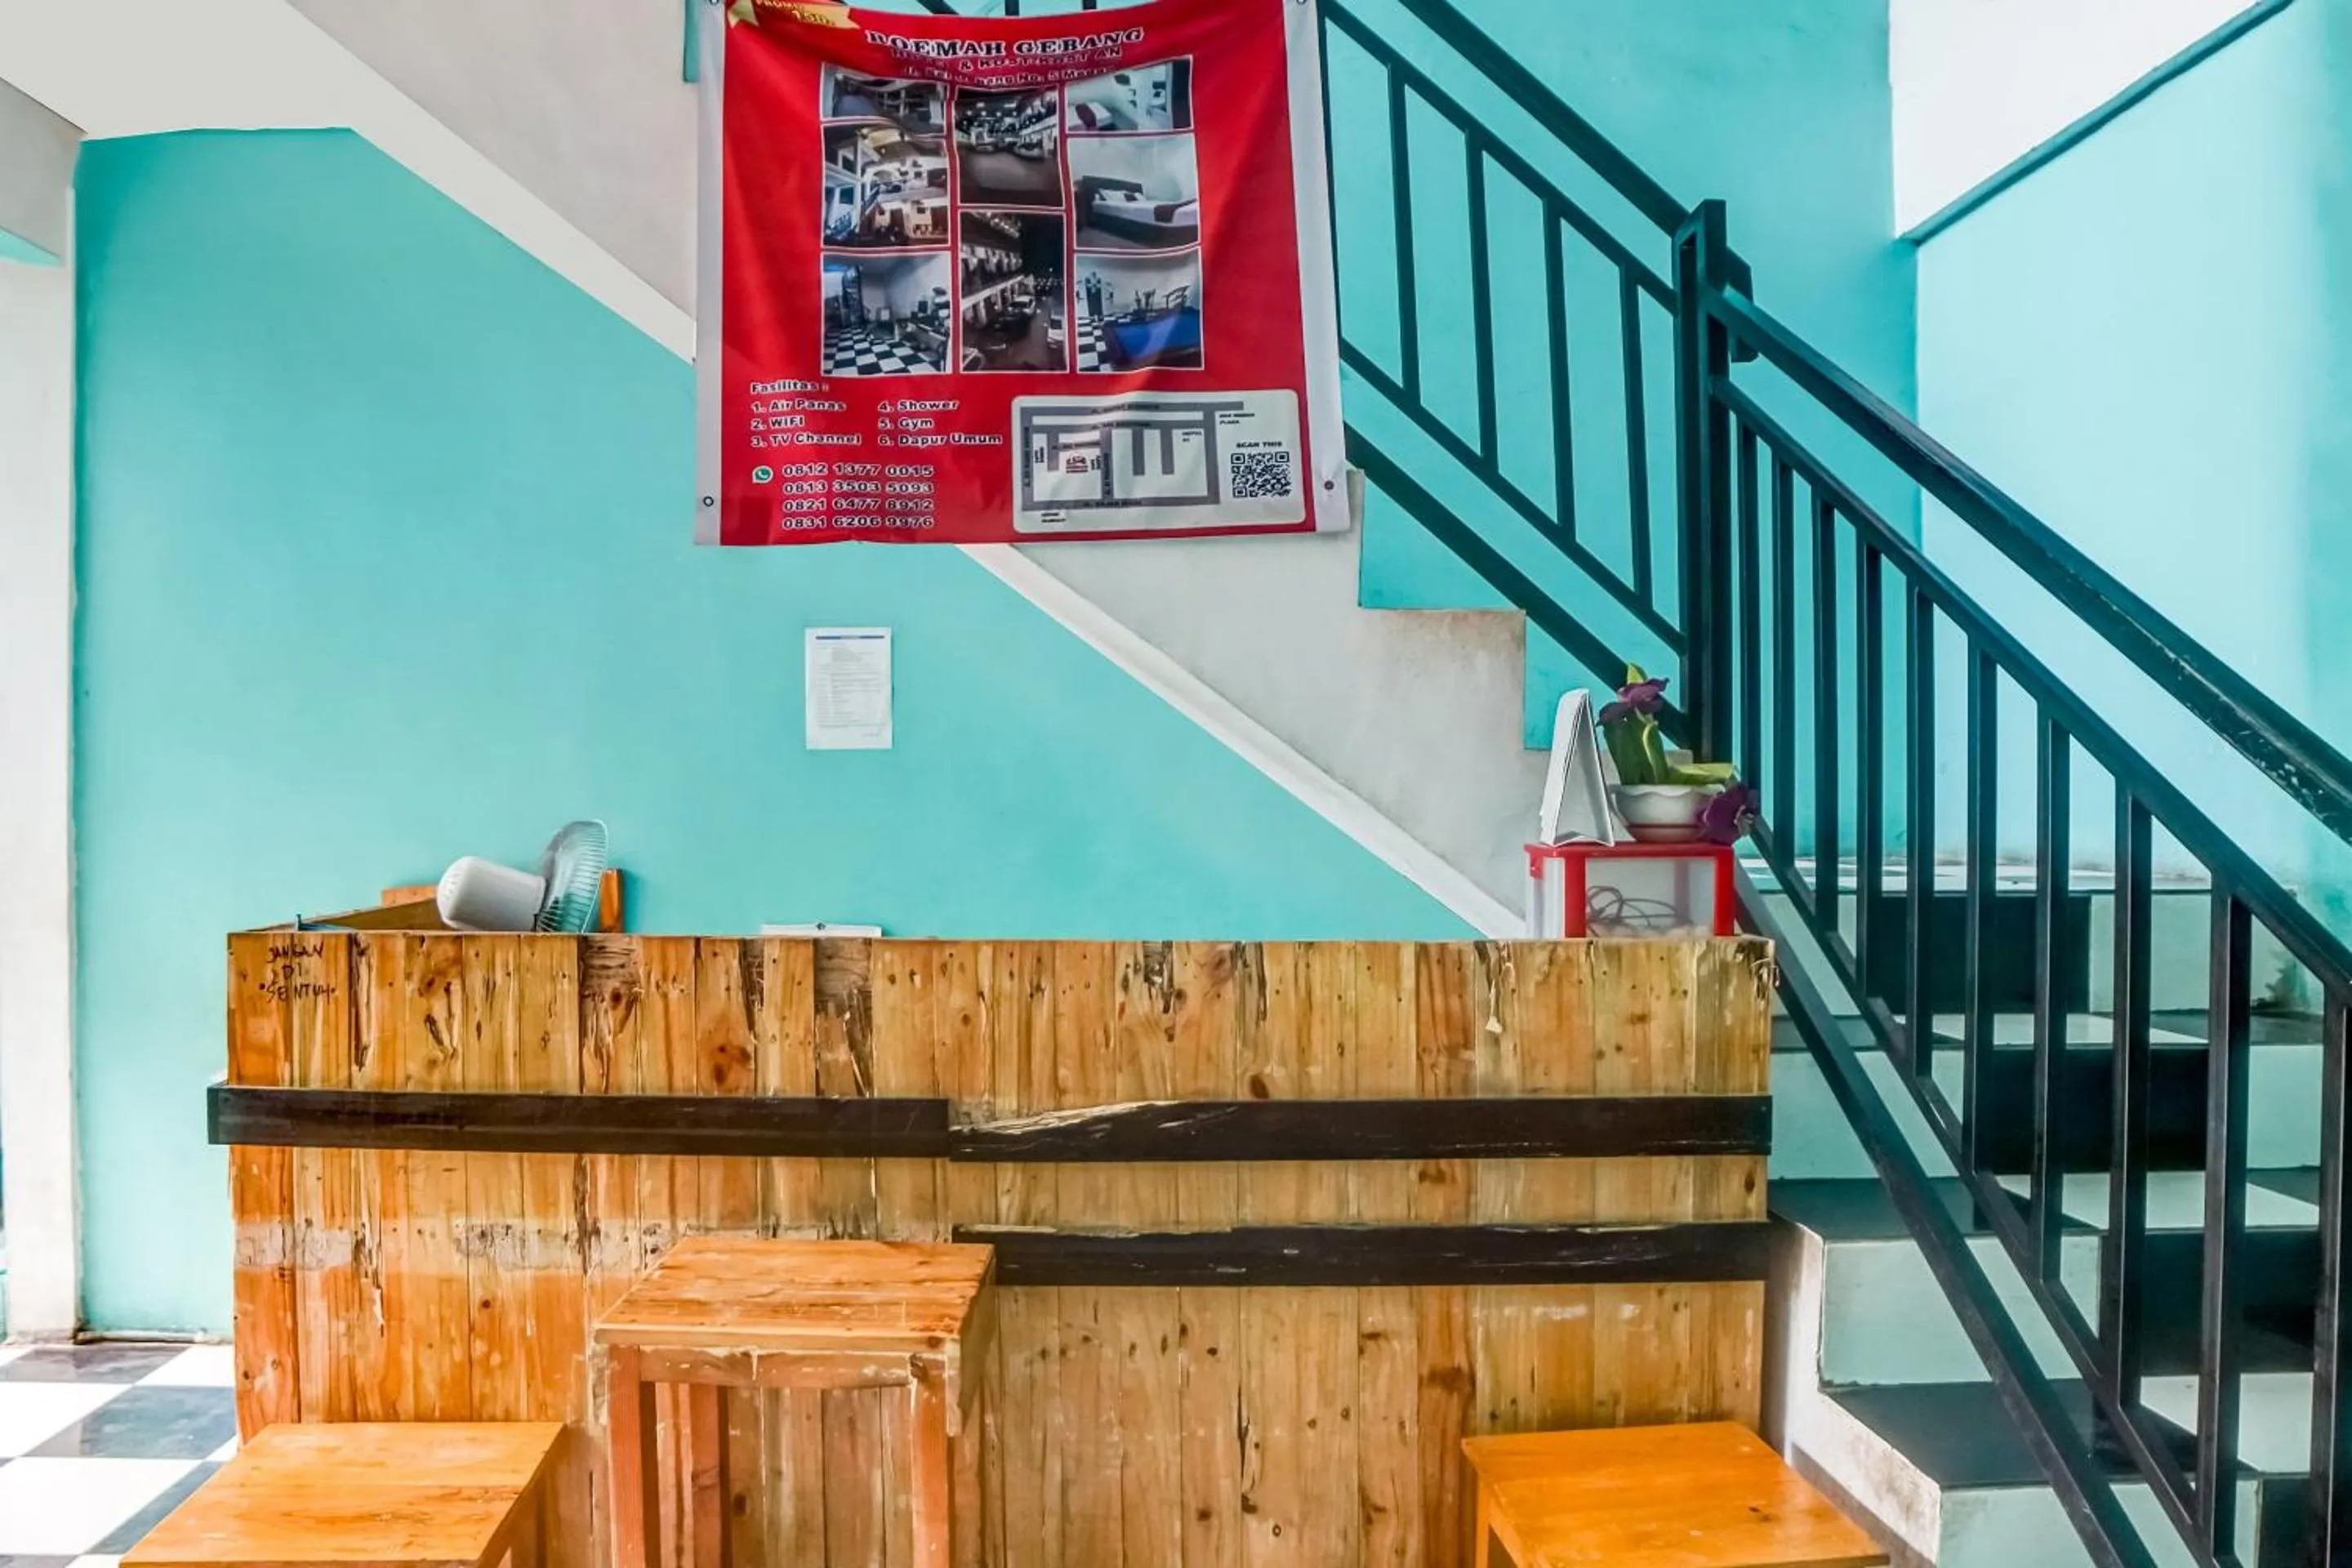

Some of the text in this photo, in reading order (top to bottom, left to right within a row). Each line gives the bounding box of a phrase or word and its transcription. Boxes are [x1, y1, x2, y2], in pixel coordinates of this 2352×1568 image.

[751, 379, 819, 394] Fasilitas
[752, 399, 847, 412] 1. Air Panas
[878, 399, 960, 412] 4. Shower
[751, 418, 766, 430] 2.
[878, 417, 934, 431] 5. Gym
[751, 430, 862, 448] 3. TV Channel
[878, 432, 1003, 448] 6. Dapur Umum
[782, 463, 934, 477] 0812 1377 0015
[782, 480, 827, 495] 0813
[832, 480, 881, 492] 3503
[782, 498, 826, 512] 0821
[832, 498, 881, 510] 6477
[782, 515, 934, 530] 0831 6206 9976
